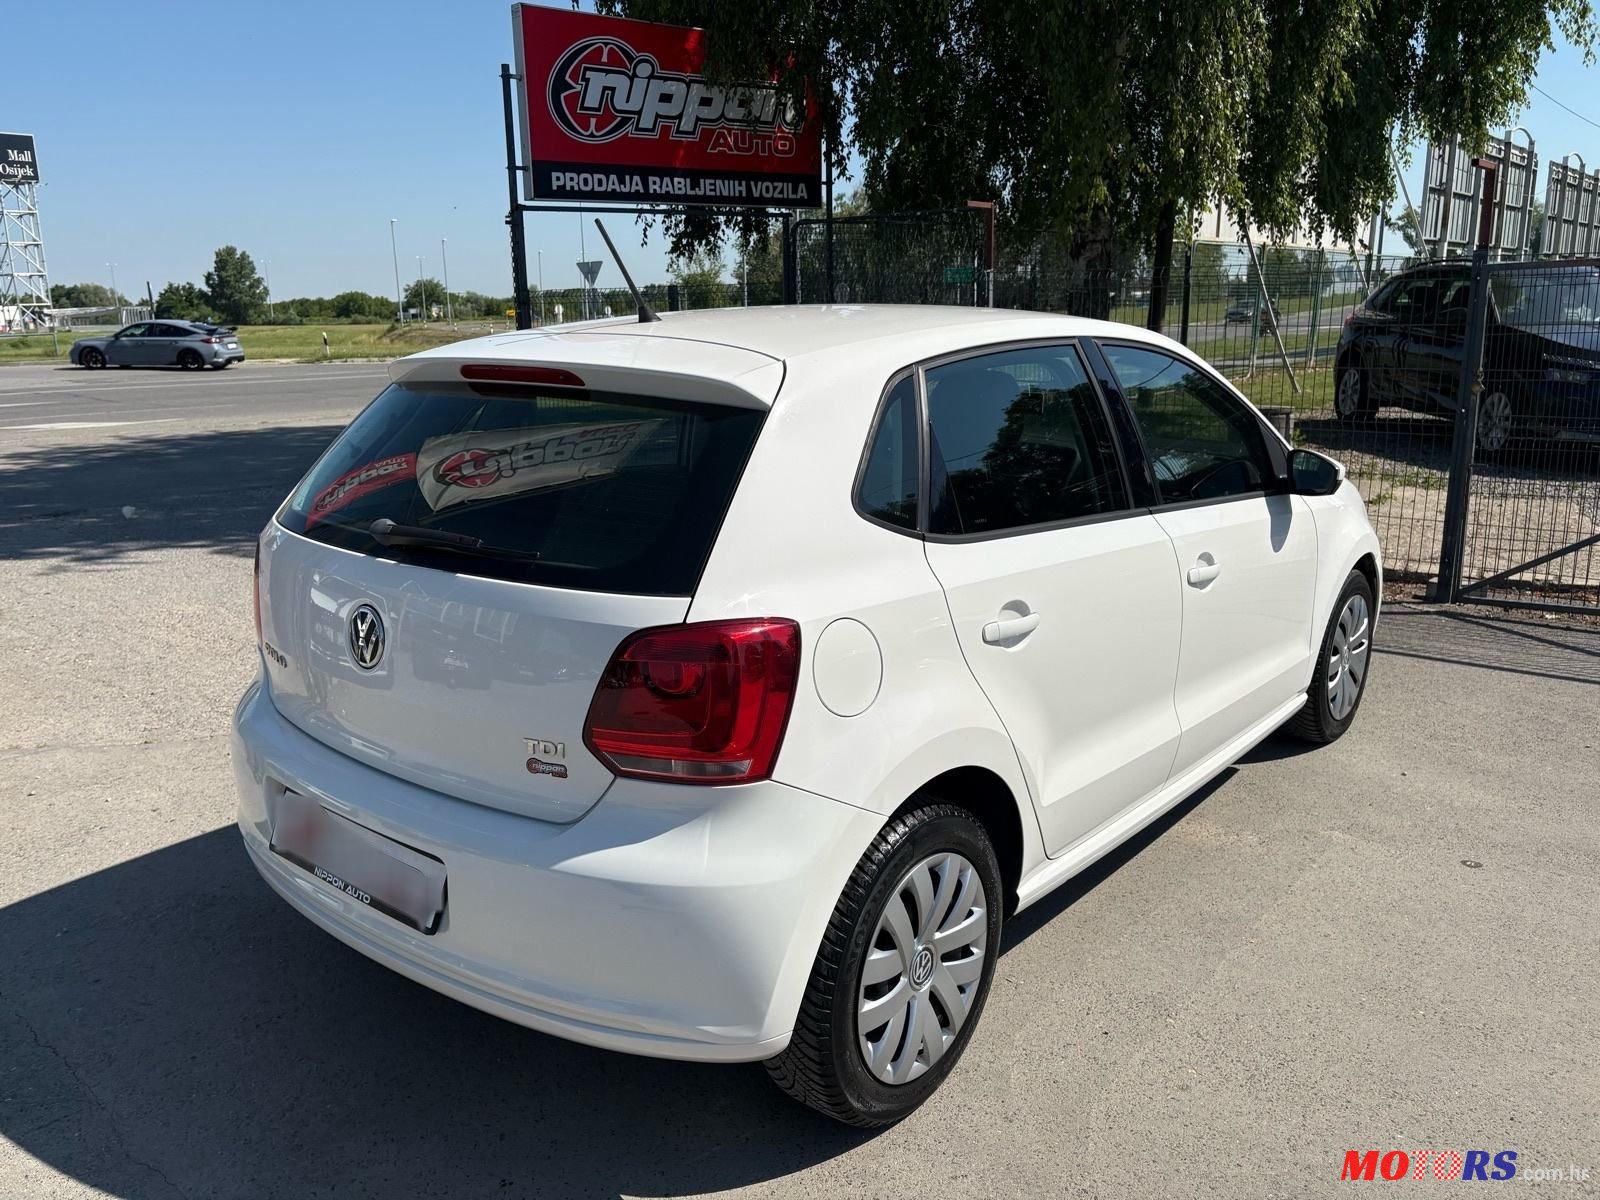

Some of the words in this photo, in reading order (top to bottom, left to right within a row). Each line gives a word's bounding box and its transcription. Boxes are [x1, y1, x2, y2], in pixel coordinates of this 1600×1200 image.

[707, 128, 796, 157] AUTO
[7, 149, 32, 162] Mall
[0, 163, 34, 178] Osijek
[551, 171, 644, 193] PRODAJA
[648, 176, 746, 197] RABLJENIH
[751, 179, 808, 200] VOZILA
[523, 737, 566, 759] TDI
[313, 866, 345, 889] NIPPON
[346, 885, 371, 904] AUTO
